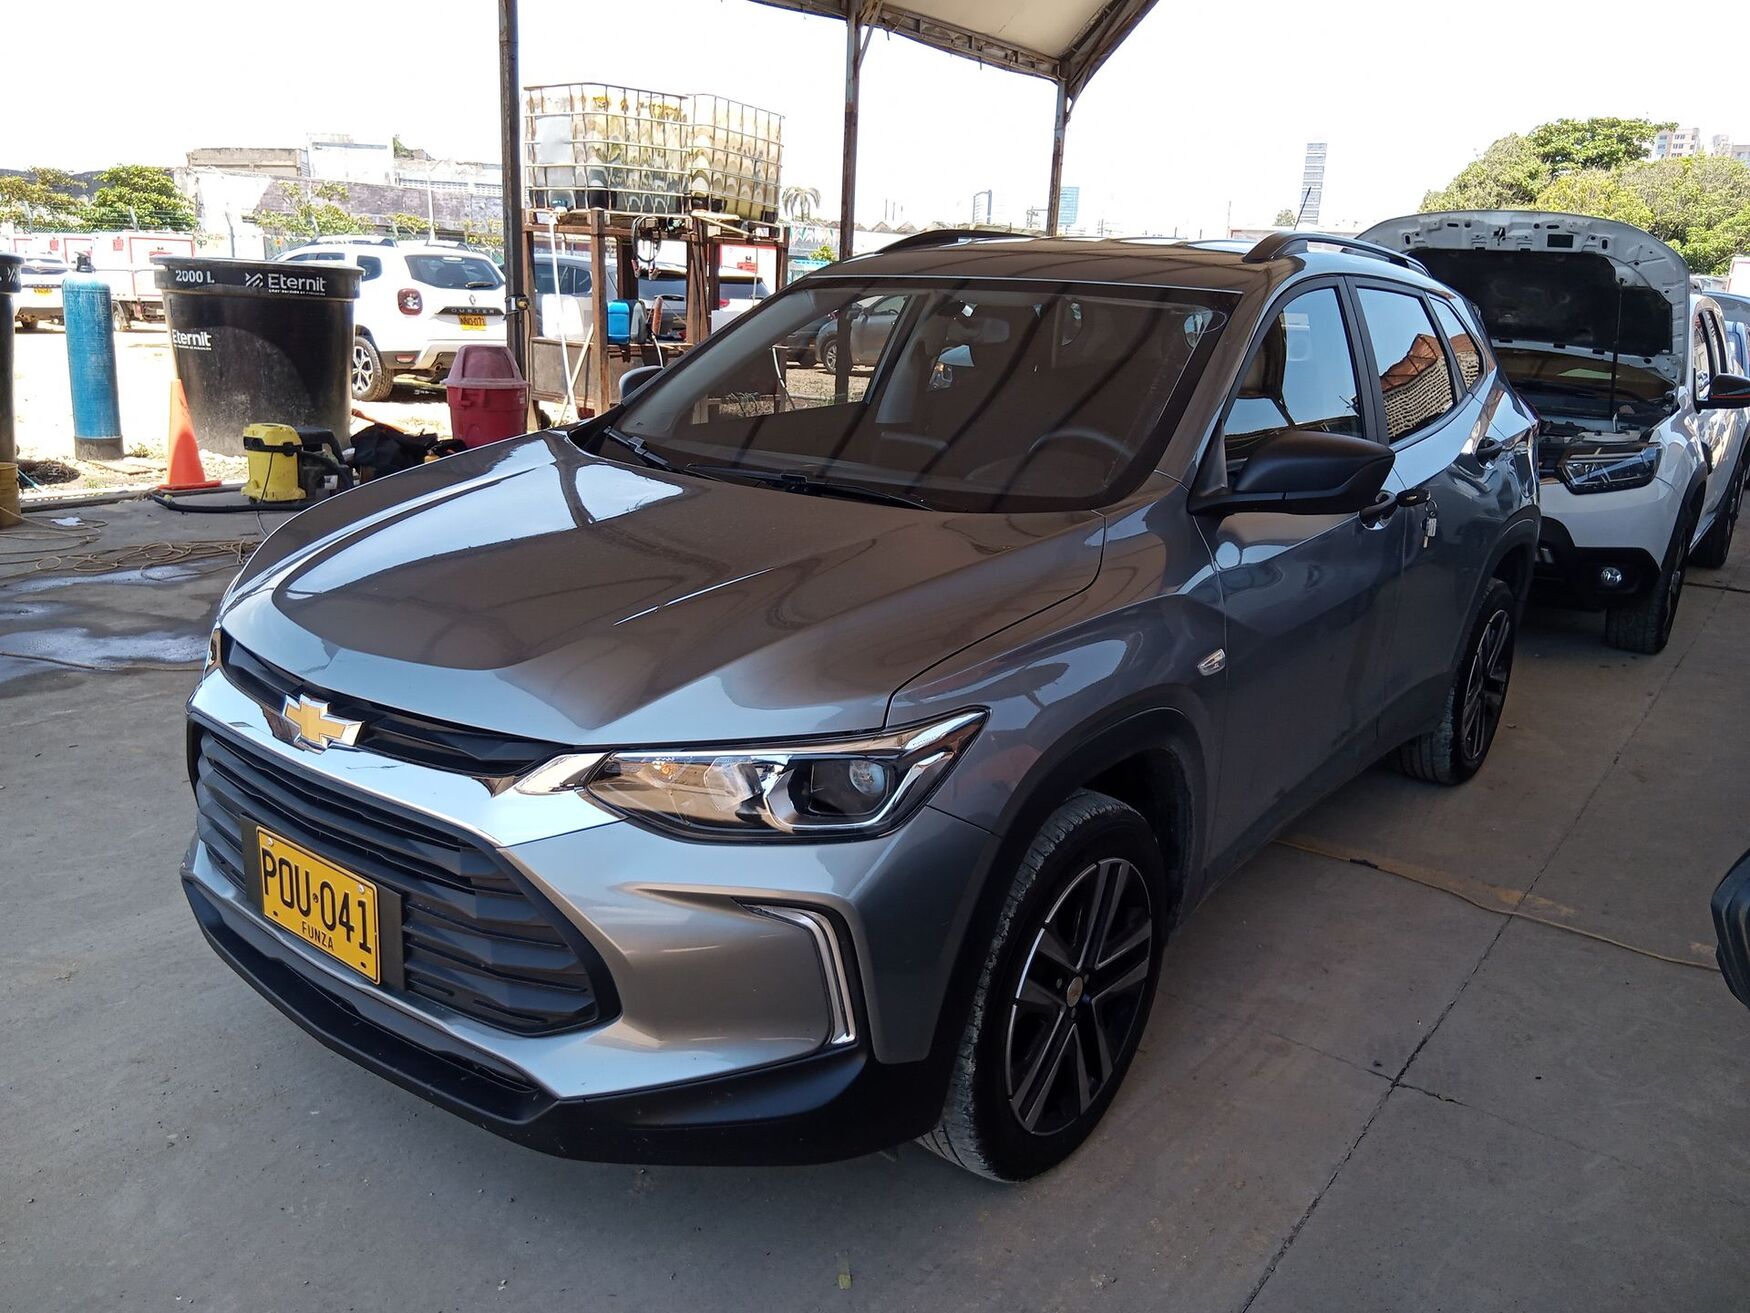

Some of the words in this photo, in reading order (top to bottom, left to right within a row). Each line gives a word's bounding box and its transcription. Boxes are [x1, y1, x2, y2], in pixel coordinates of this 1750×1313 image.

[175, 269, 204, 283] 2000
[206, 270, 215, 283] L
[267, 273, 327, 292] Eternit
[172, 328, 212, 347] Eternit
[301, 921, 335, 952] FUNZA
